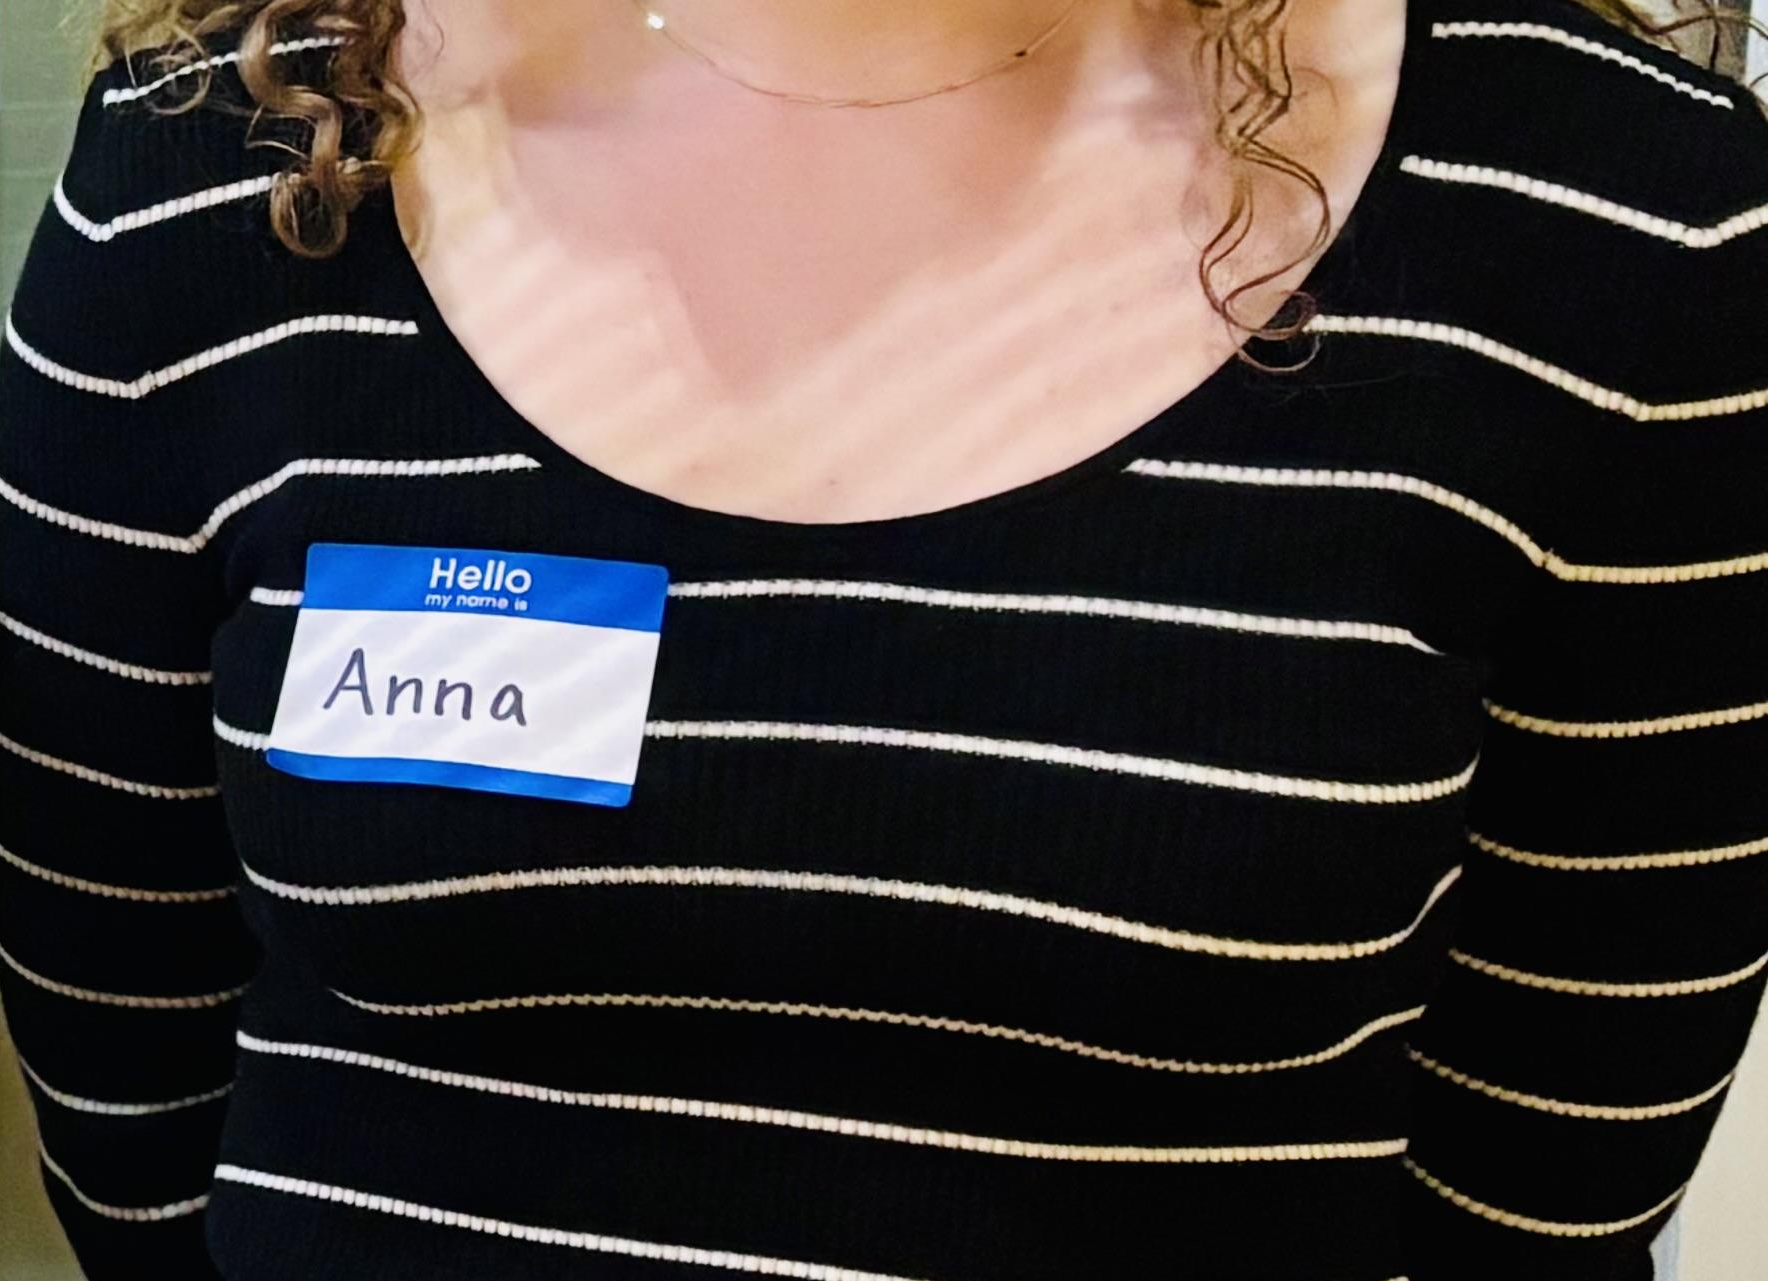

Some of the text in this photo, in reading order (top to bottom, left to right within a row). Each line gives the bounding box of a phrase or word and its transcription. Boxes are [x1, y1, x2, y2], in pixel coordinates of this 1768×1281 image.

[429, 558, 532, 594] Hello
[425, 592, 452, 608] my
[457, 594, 508, 609] name
[323, 647, 527, 726] Anna
